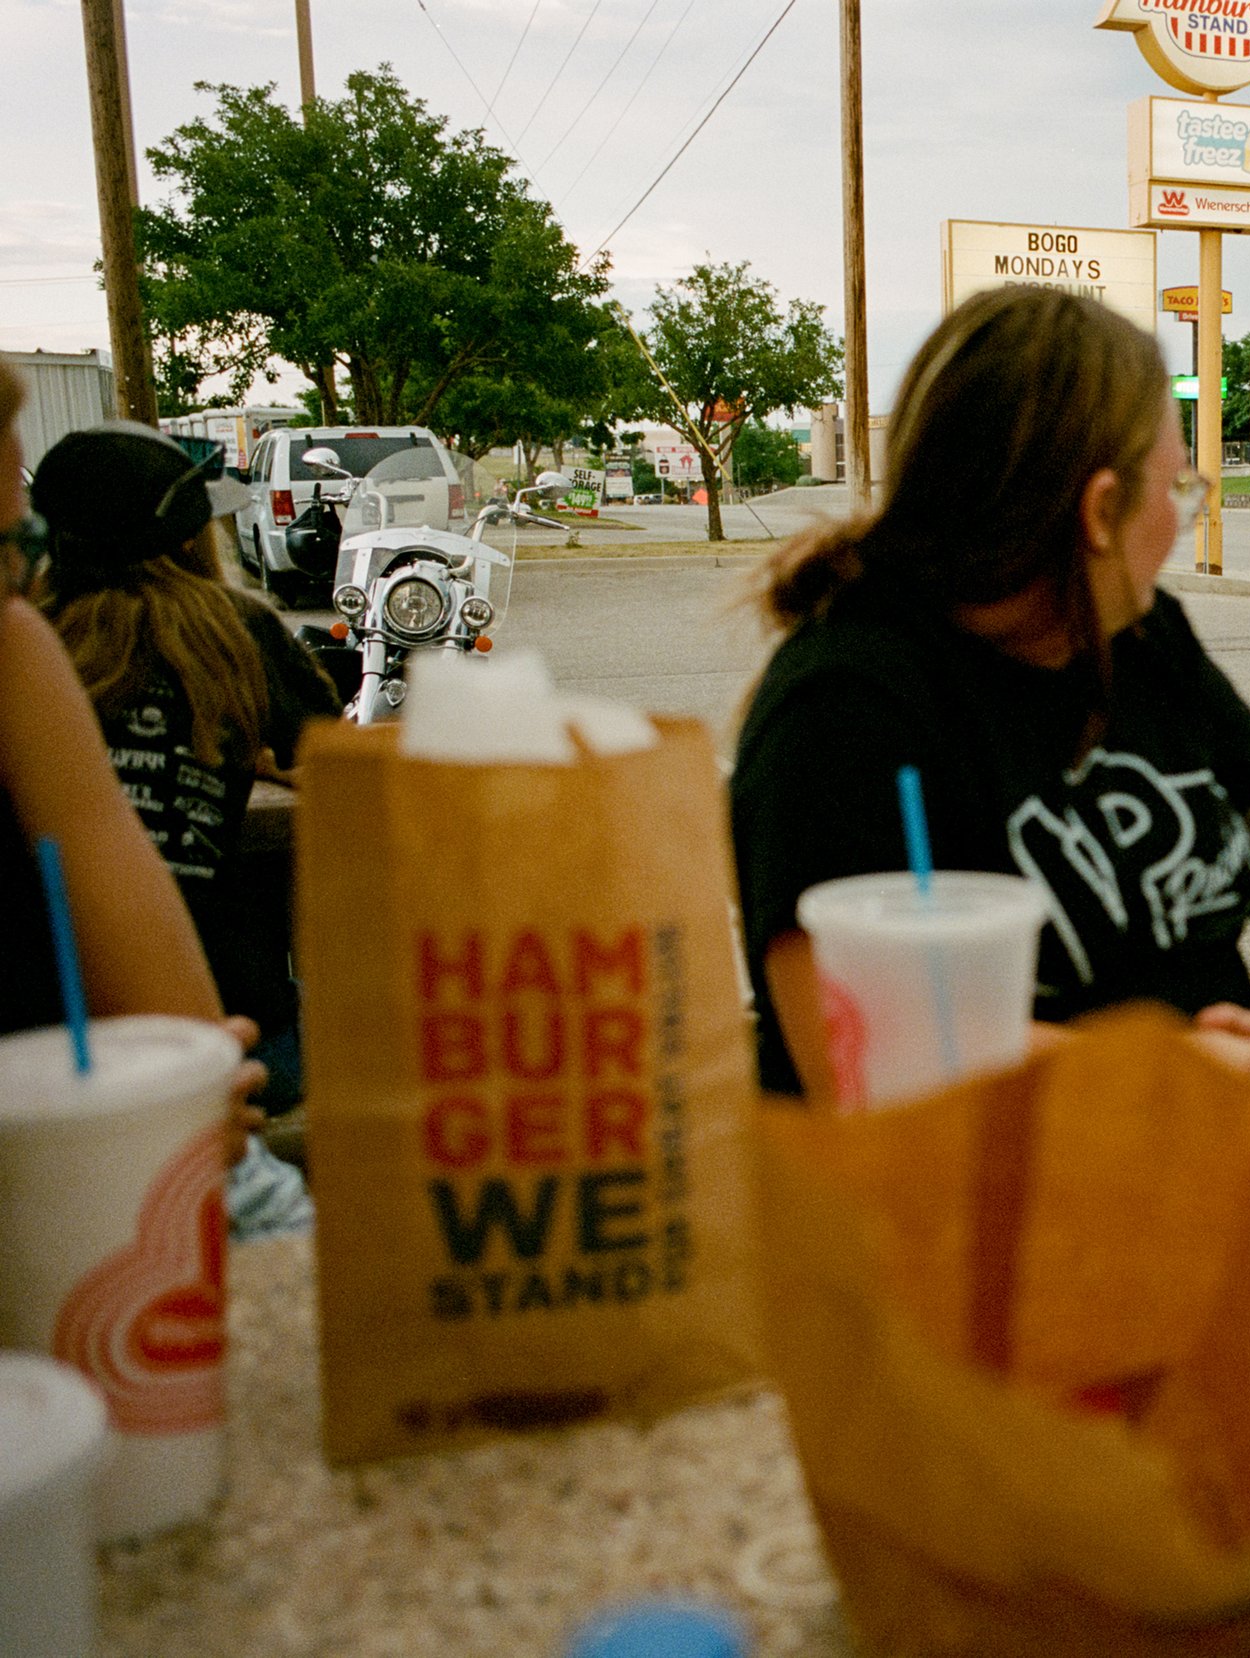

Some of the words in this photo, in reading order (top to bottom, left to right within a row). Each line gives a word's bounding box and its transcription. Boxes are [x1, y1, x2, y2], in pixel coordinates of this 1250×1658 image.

[1188, 14, 1248, 35] STAND
[1177, 110, 1248, 140] tastee
[1184, 136, 1242, 167] freez
[1028, 232, 1078, 253] BOGO
[994, 255, 1101, 280] MONDAYS
[1167, 295, 1194, 306] TACO
[569, 478, 602, 492] ORAGE
[574, 468, 596, 480] SELF-
[415, 928, 646, 1000] HAM
[420, 1010, 648, 1083] BUR
[422, 1092, 650, 1171] GER
[427, 1167, 650, 1266] WE
